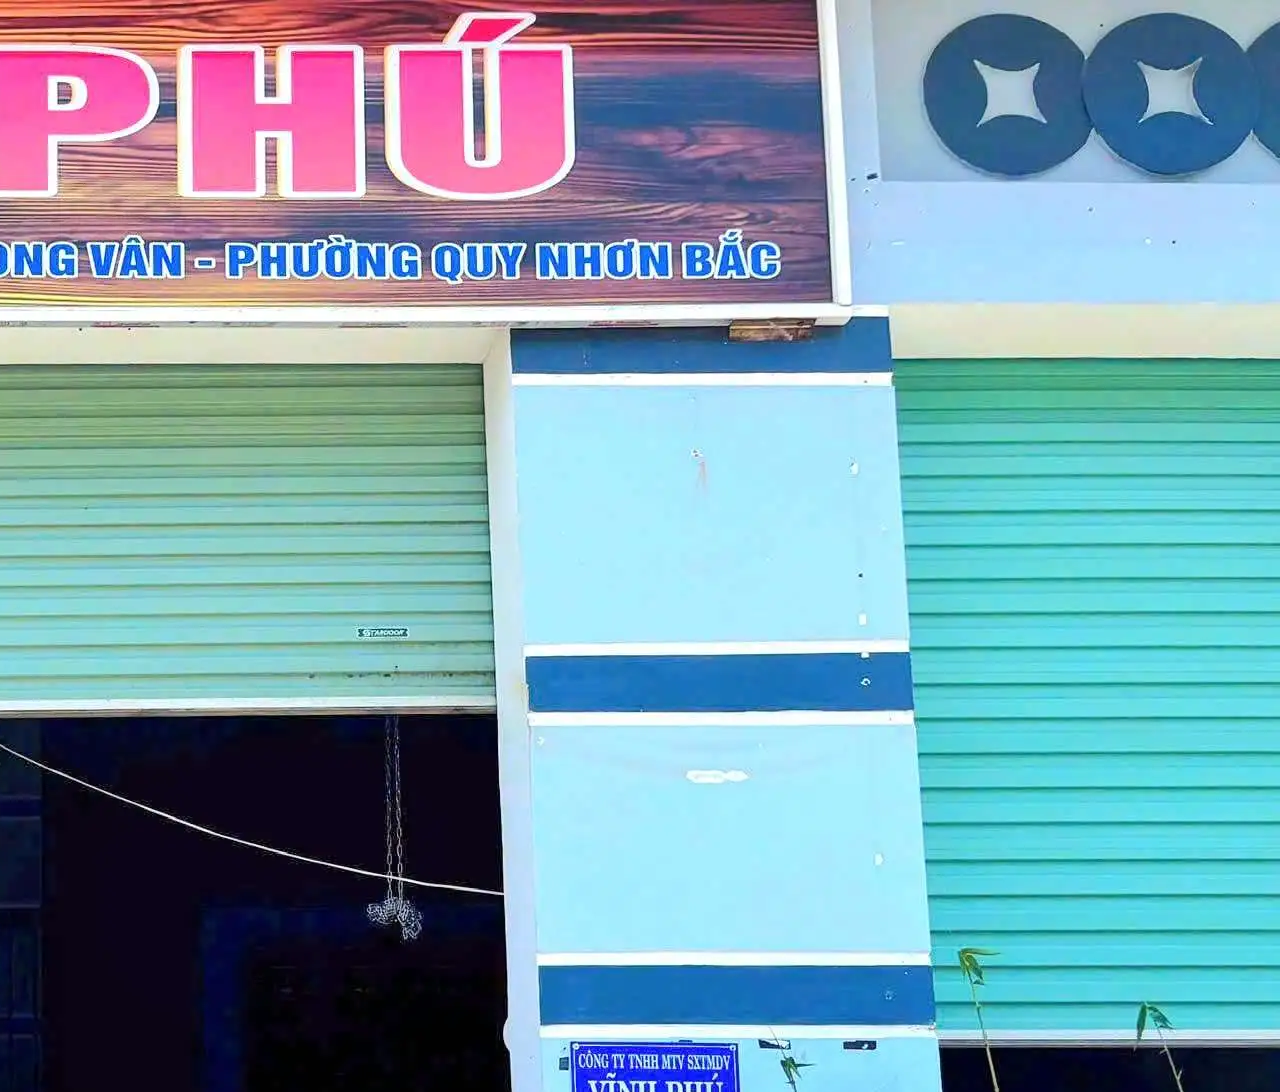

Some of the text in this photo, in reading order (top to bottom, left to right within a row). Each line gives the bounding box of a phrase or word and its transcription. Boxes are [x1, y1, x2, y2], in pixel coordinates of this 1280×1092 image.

[87, 236, 184, 278] VÂN
[226, 236, 421, 280] PHƯỜNG
[431, 243, 526, 284] QUY
[536, 240, 672, 279] NHƠN
[683, 230, 781, 279] BẮC
[578, 1051, 730, 1071] CÔNG TY TNHH MTV SXTMDV
